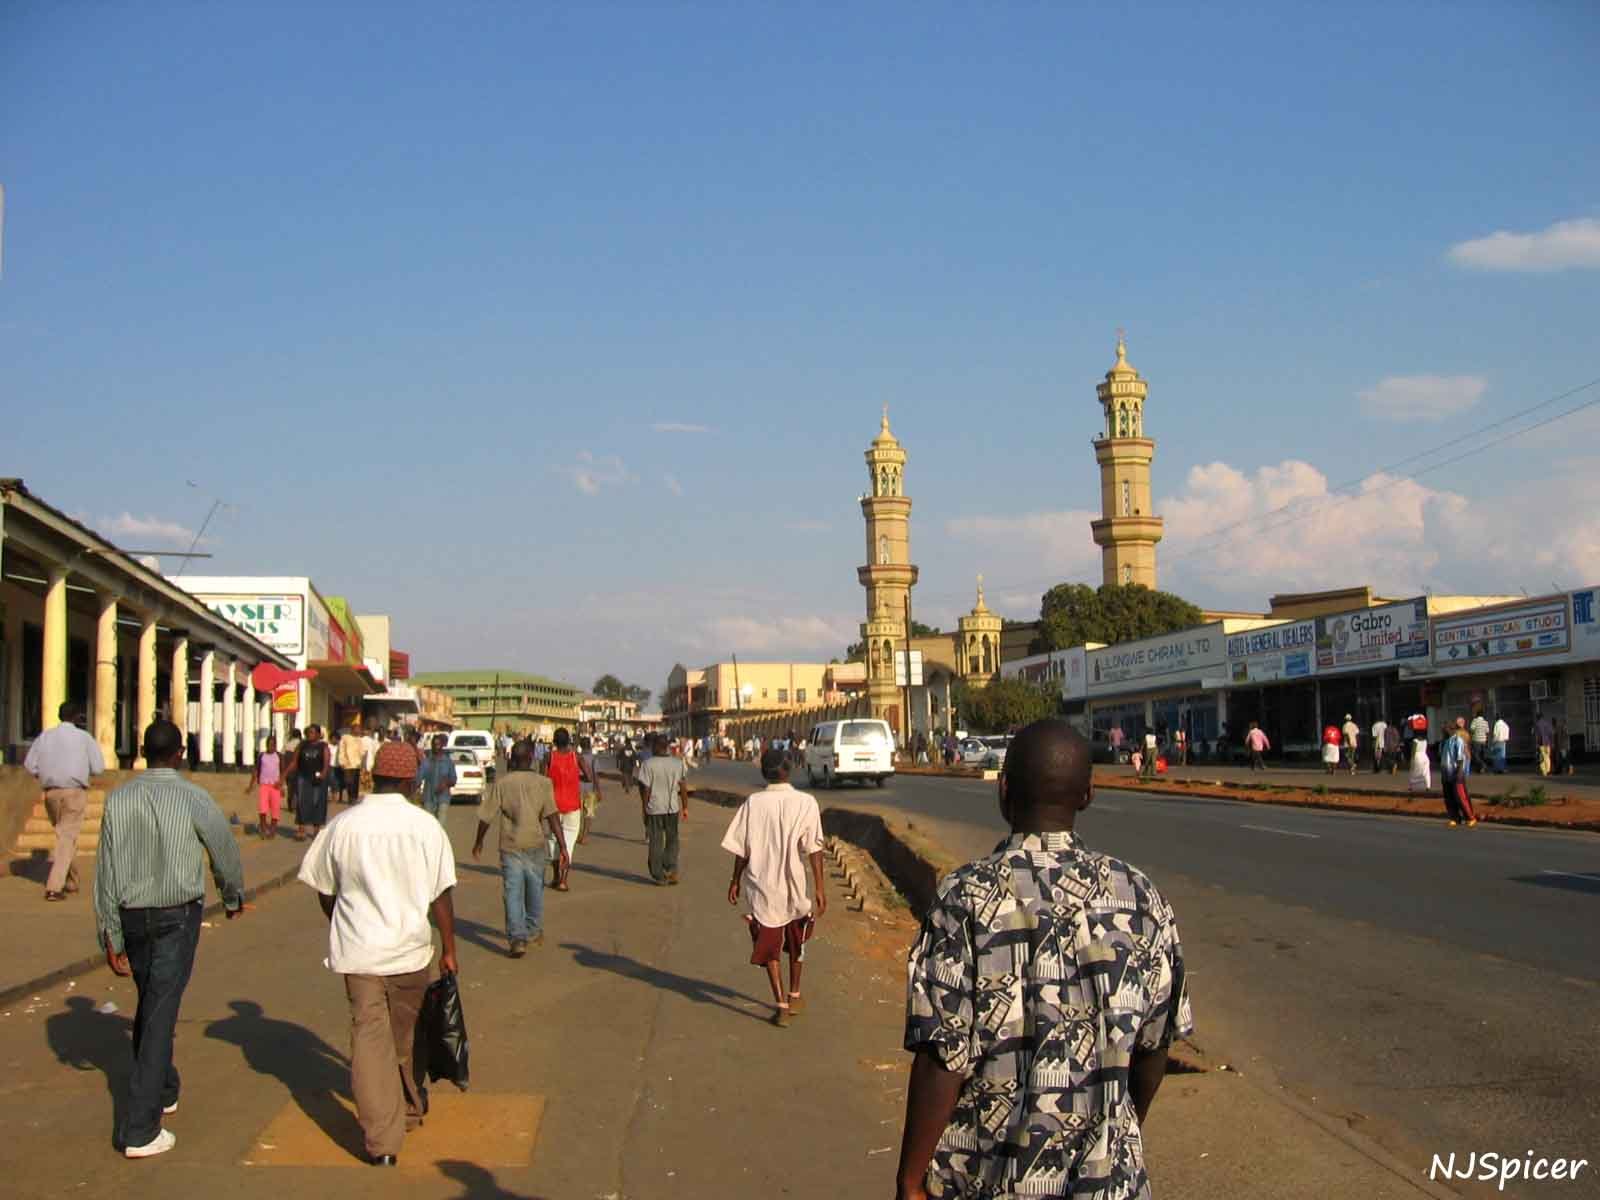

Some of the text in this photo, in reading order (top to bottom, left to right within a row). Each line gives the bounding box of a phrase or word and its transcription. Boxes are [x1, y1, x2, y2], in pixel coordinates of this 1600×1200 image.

[1351, 612, 1391, 632] Gabro
[1438, 628, 1478, 642] CENTRAL
[1483, 621, 1520, 635] AFRICAN
[1526, 614, 1561, 630] STUDIO
[1187, 639, 1210, 656] LTD
[1251, 632, 1281, 653] GENERAL
[1283, 624, 1313, 646] DEALERS
[1360, 626, 1402, 648] Limited
